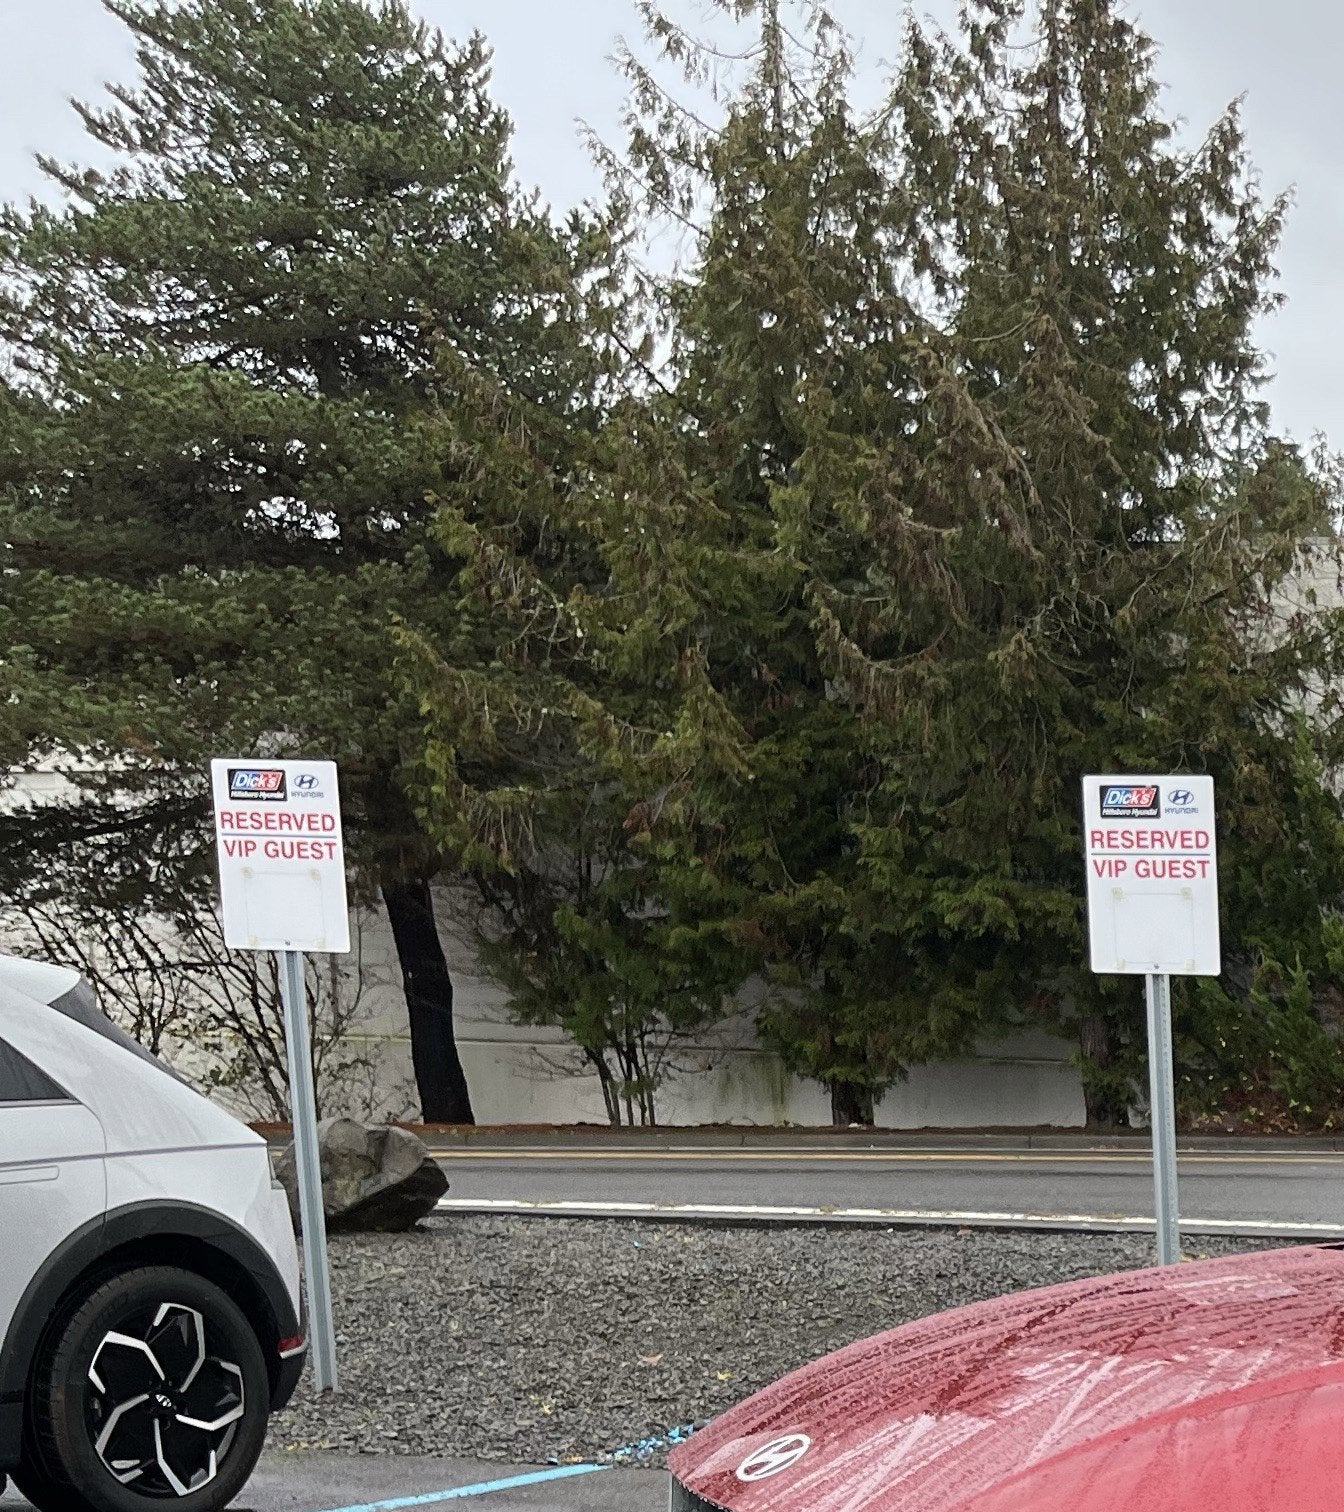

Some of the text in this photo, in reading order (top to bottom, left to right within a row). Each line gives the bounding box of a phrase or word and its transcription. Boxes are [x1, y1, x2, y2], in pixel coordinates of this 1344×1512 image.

[220, 811, 336, 832] RESERVED
[1090, 830, 1210, 849] RESERVED
[223, 840, 337, 860] VIP GUEST
[1093, 859, 1211, 879] VIP GUEST
